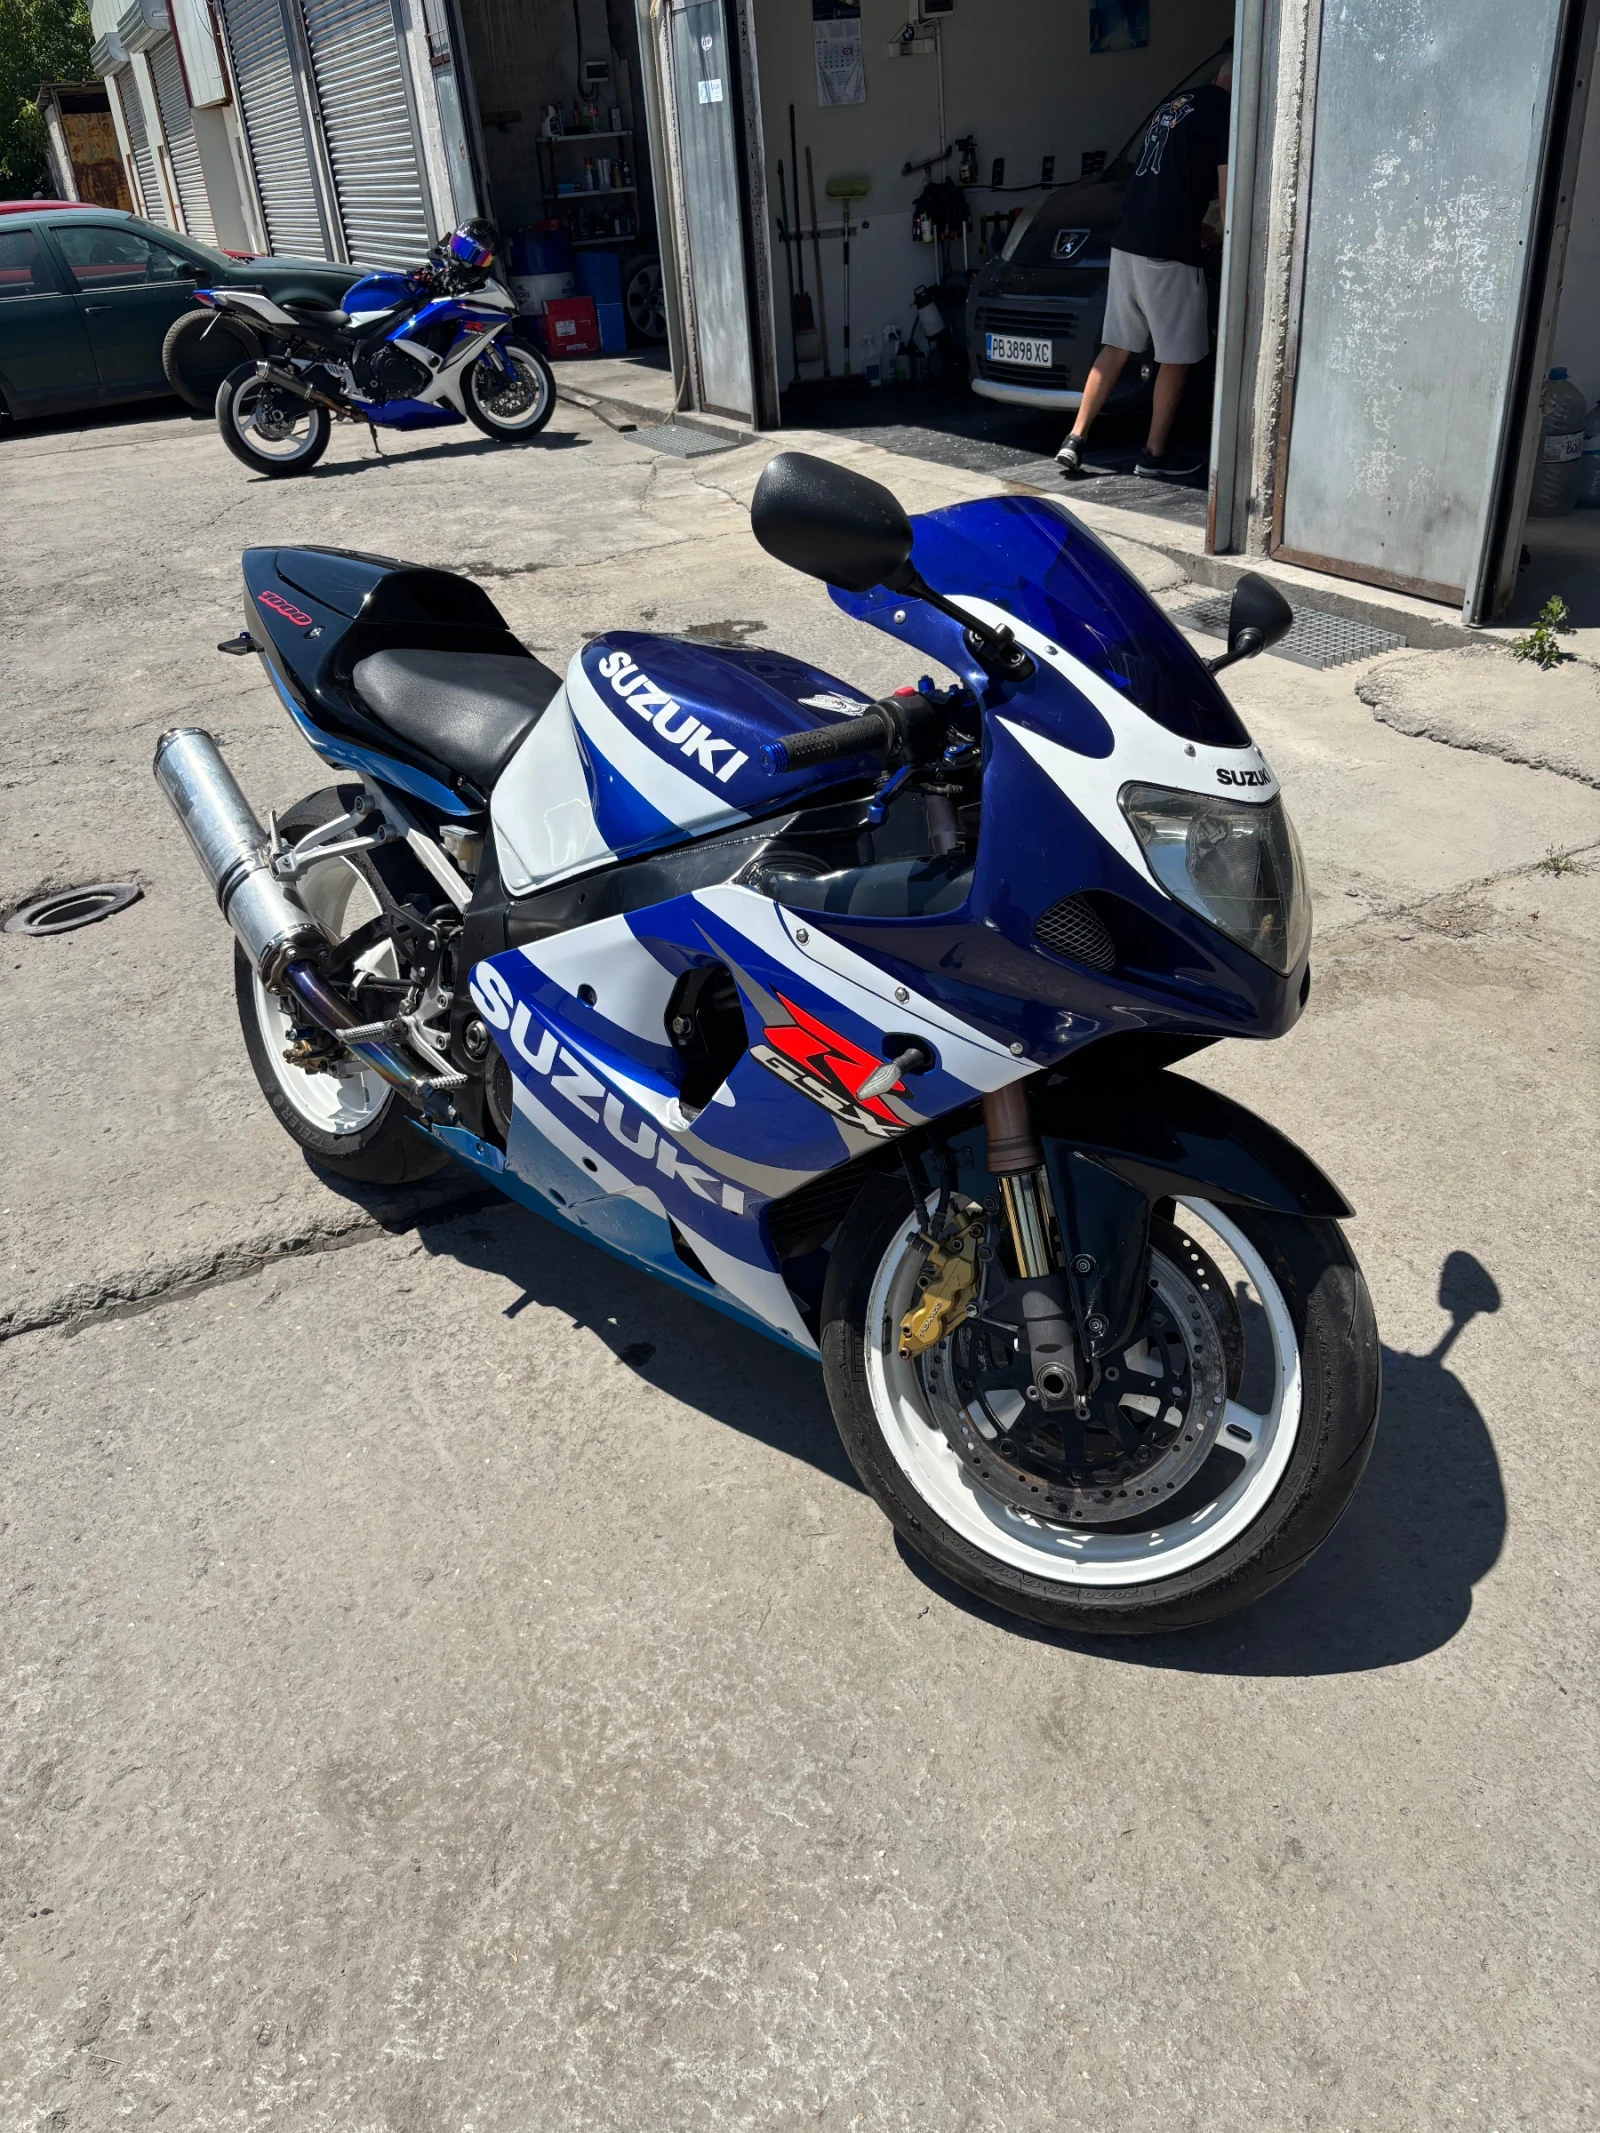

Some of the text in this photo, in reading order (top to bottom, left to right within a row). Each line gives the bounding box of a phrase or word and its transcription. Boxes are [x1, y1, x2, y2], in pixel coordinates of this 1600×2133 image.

[565, 342, 589, 352] MOTUL
[992, 338, 1049, 363] PB 3898 XC
[257, 590, 313, 626] 1000
[598, 651, 750, 784] SUZUKI
[469, 960, 745, 1215] SUZUKI
[1082, 1588, 1145, 1601] 120/70
